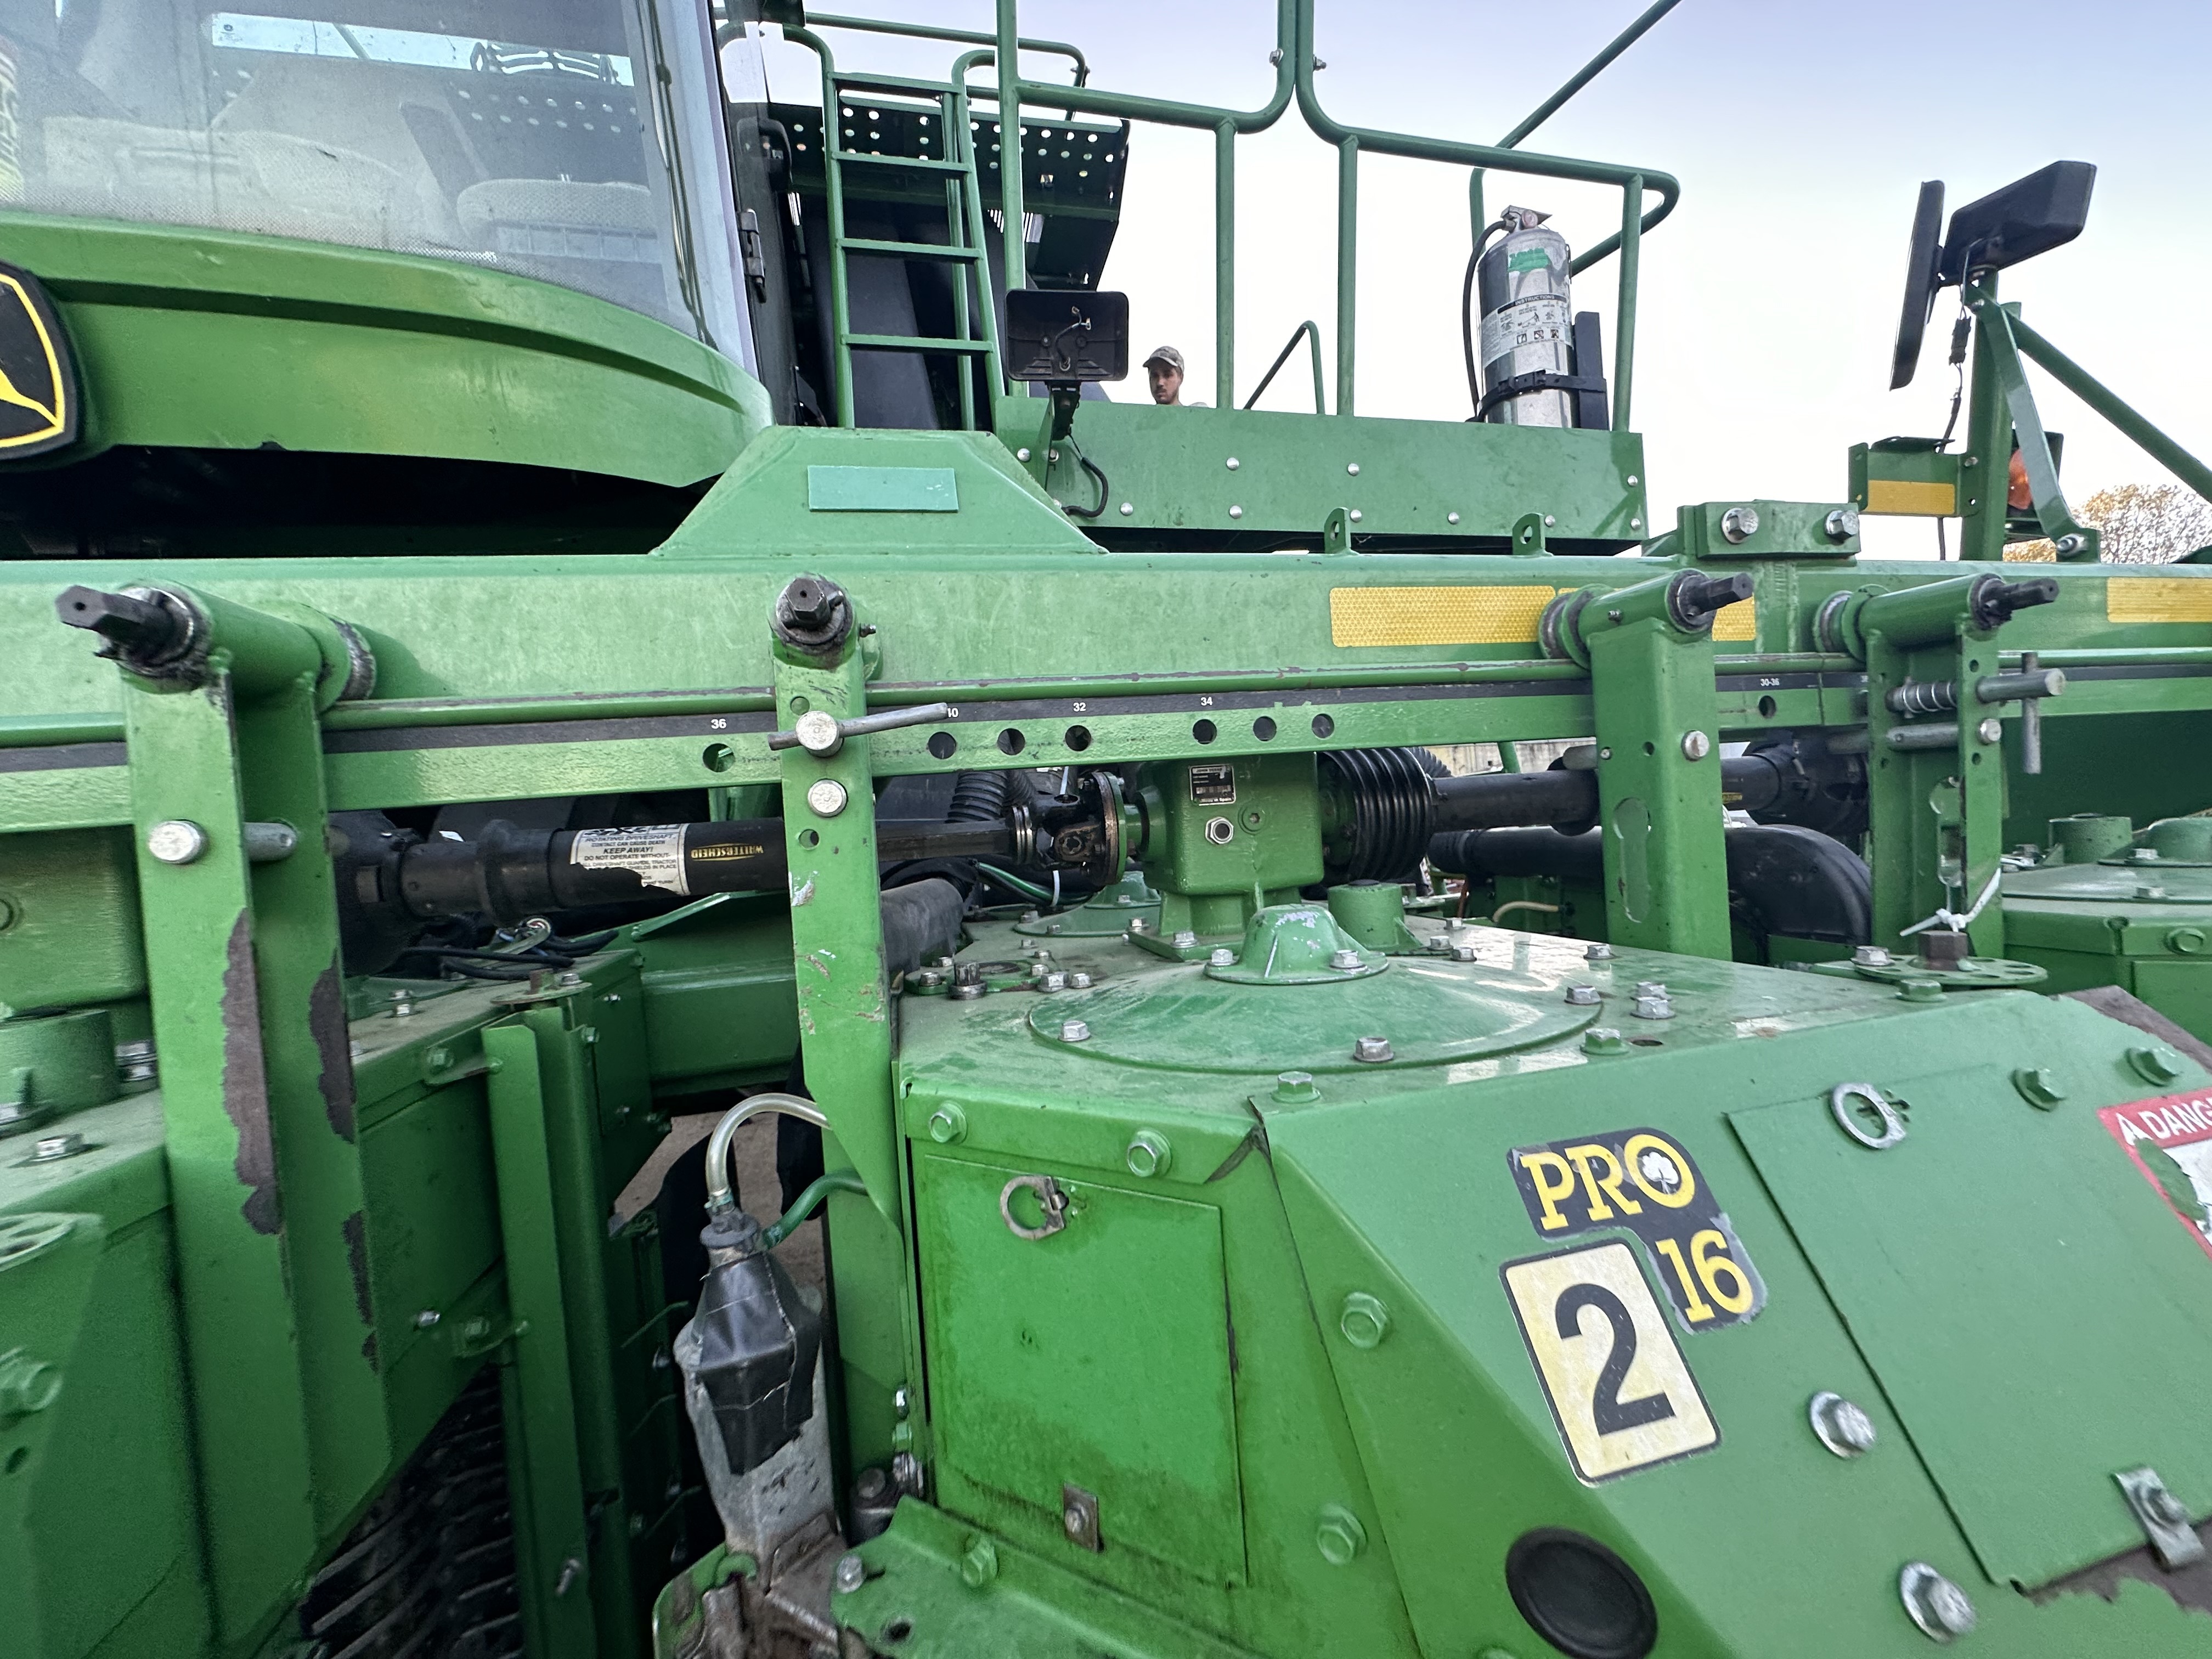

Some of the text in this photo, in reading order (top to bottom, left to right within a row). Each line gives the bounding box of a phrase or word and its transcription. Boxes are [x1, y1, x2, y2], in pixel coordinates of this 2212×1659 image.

[1515, 295, 1555, 306] INSTRUCTIONS
[1073, 702, 1086, 712] 32
[1200, 696, 1213, 706] 34
[711, 718, 727, 729] 36
[2137, 1097, 2212, 1139] DANG
[1520, 1134, 1695, 1230] PRO
[1656, 1229, 1753, 1323] 16
[1555, 1283, 1677, 1436] 2
